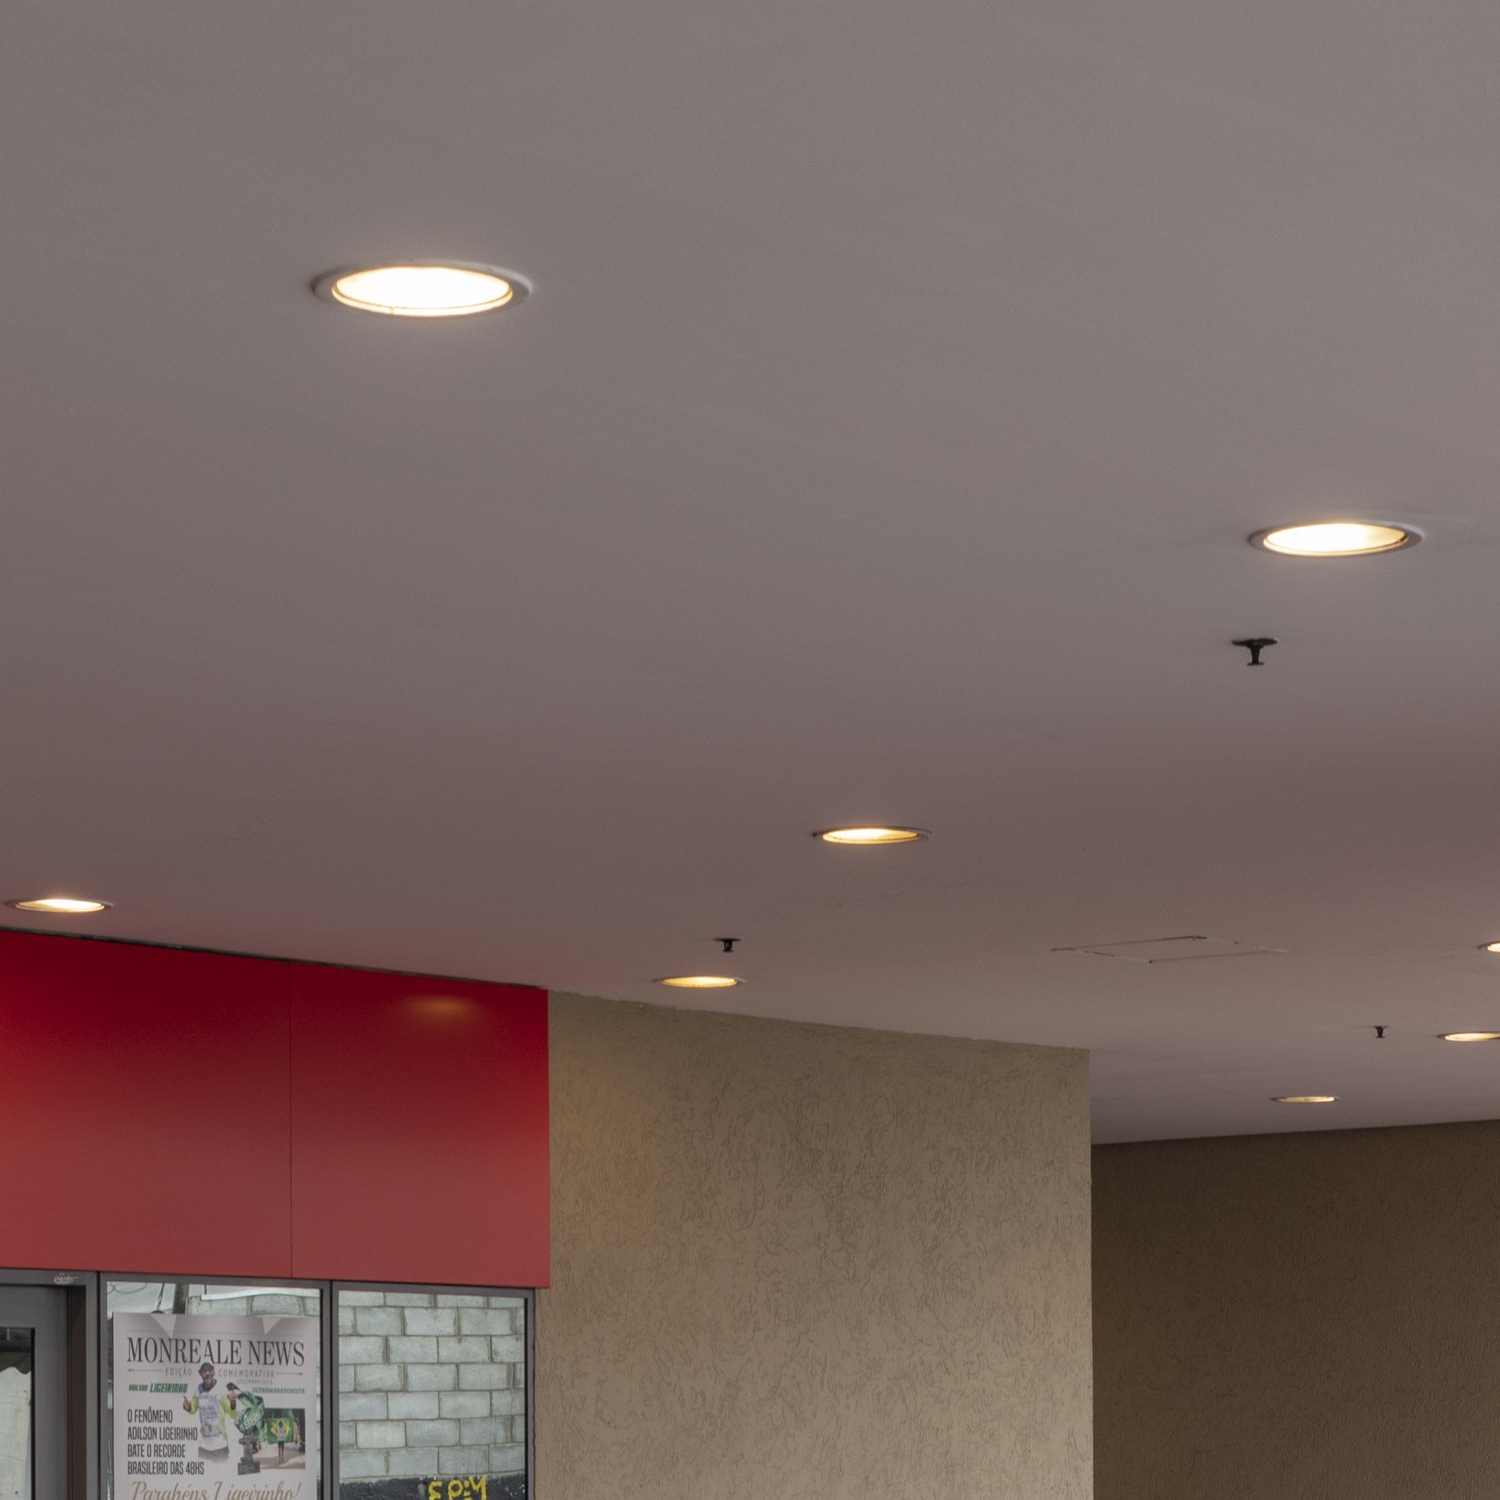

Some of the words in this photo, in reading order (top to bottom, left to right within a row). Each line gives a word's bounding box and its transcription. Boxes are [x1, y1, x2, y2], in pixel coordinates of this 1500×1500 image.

[126, 1337, 242, 1365] MONREALE
[248, 1340, 305, 1366] NEWS
[127, 1409, 133, 1423] O
[134, 1405, 173, 1423] FENÔMENO
[127, 1427, 157, 1441] ADILSON
[159, 1427, 198, 1441] LIGEIRINHO
[127, 1444, 144, 1458] BATE
[146, 1444, 152, 1458] O
[153, 1444, 186, 1458] RECORDE
[127, 1461, 168, 1475] BRASILEIRO
[170, 1461, 184, 1475] DAS
[185, 1461, 204, 1475] 48HS
